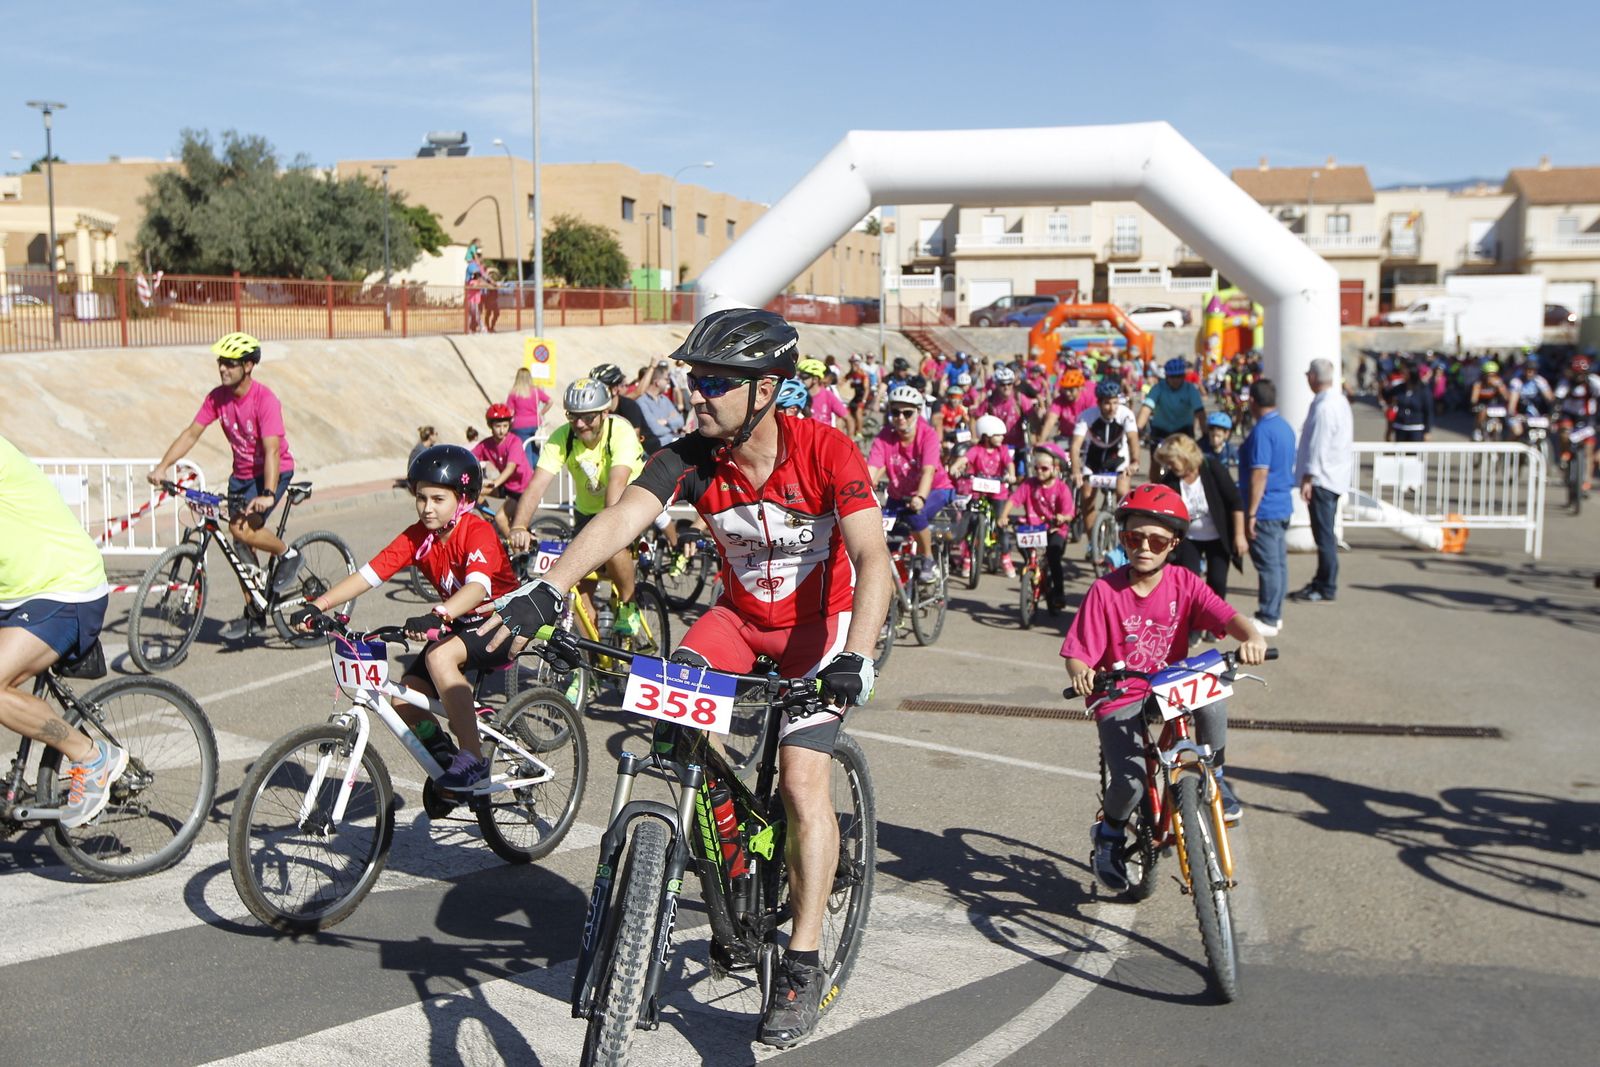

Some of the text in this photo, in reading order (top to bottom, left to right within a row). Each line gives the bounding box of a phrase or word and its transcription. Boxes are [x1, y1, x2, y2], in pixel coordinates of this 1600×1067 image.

[1021, 534, 1042, 546] 471
[339, 660, 381, 686] 114
[635, 683, 717, 725] 358
[1167, 673, 1222, 708] 472
